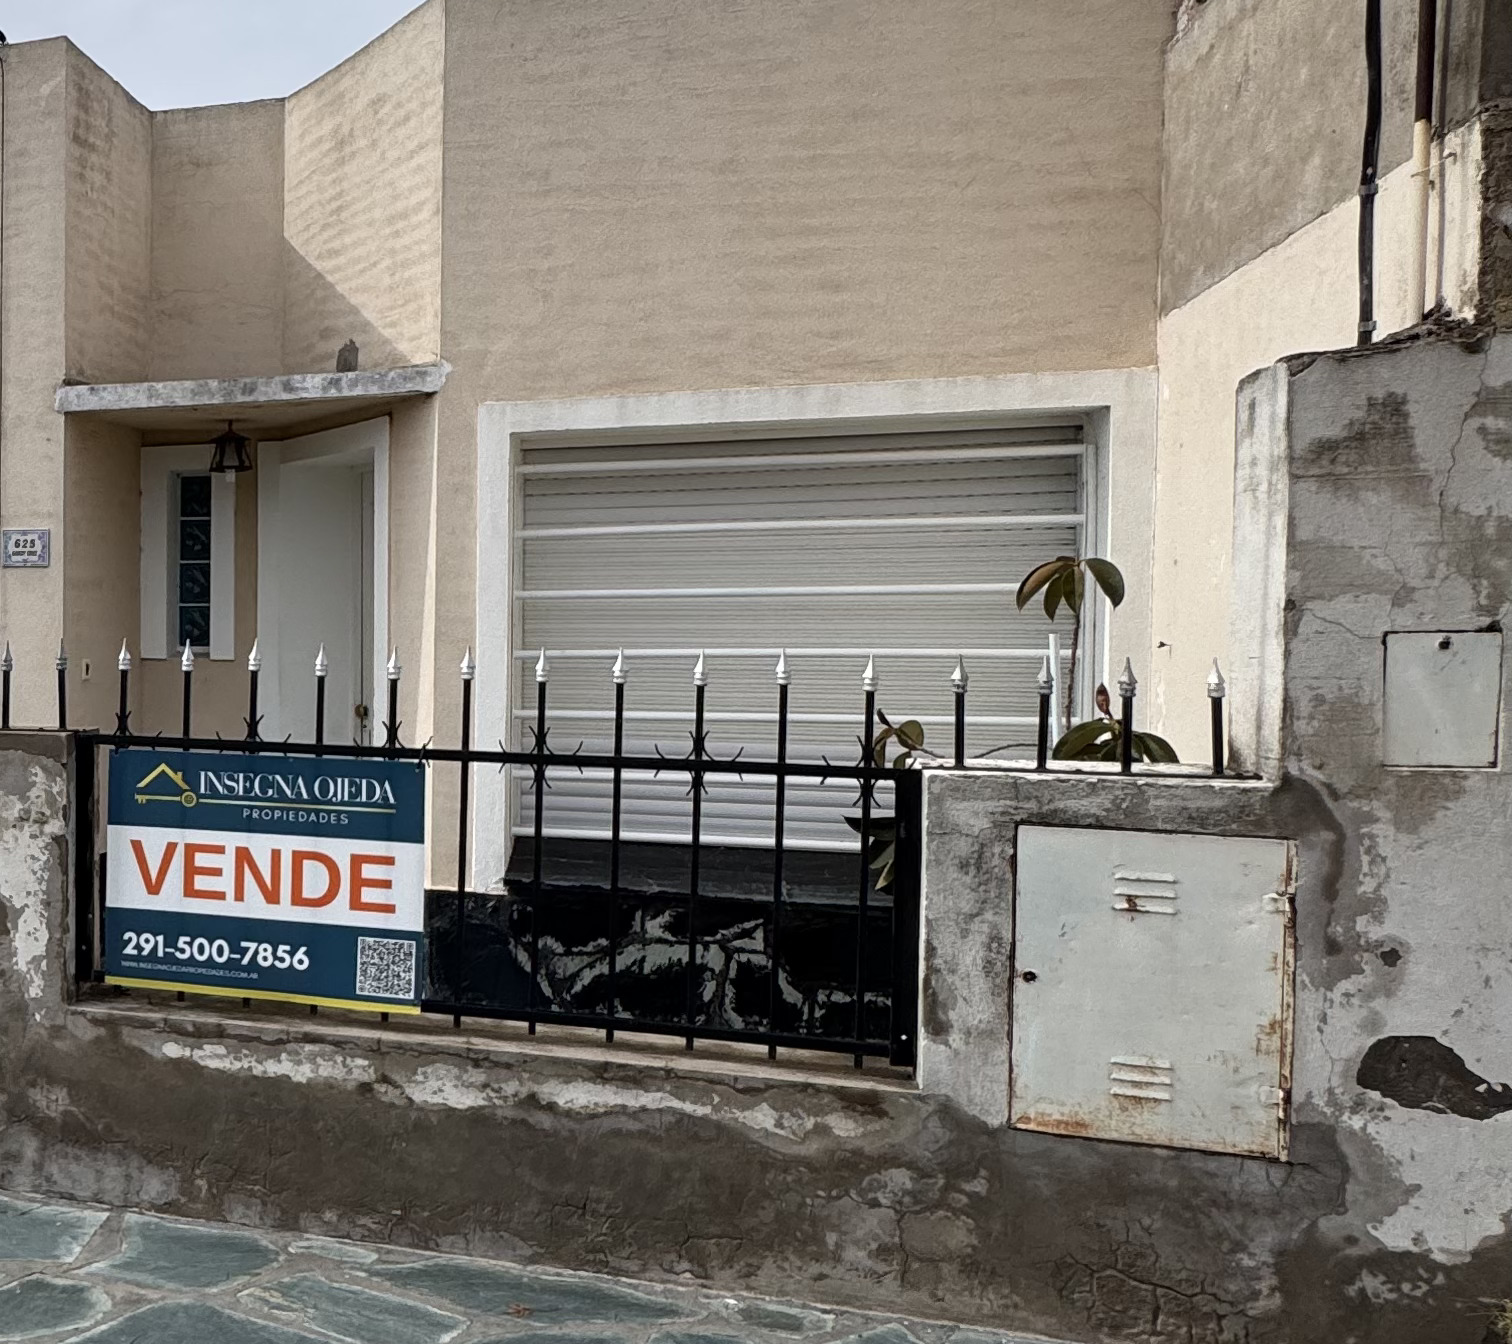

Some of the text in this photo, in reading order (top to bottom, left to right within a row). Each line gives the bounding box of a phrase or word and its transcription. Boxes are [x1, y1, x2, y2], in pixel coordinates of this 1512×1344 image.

[199, 771, 397, 804] INSEGNA OJEDA
[242, 807, 349, 825] PROPIEDADES
[129, 839, 396, 914] VENDE
[121, 931, 310, 971] 291-500-7856
